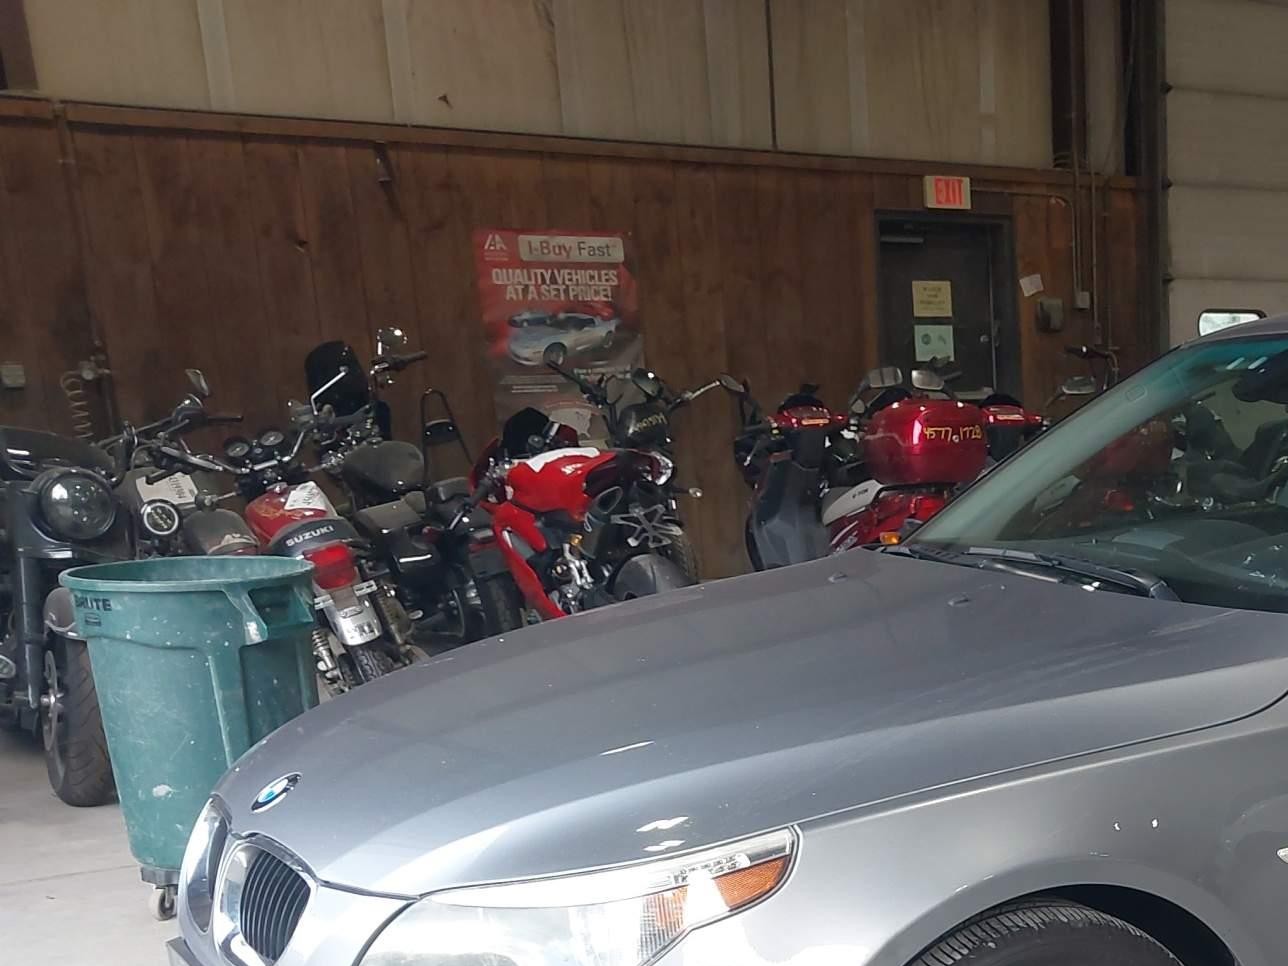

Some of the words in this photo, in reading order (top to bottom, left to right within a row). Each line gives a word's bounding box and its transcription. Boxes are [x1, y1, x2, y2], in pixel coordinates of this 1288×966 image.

[492, 268, 552, 285] QUALITY
[554, 269, 619, 286] VEHICLES
[506, 286, 526, 301] AT
[527, 286, 539, 301] A
[541, 286, 567, 301] SET
[569, 286, 613, 302] PRICE!
[285, 524, 335, 547] SUZUKI
